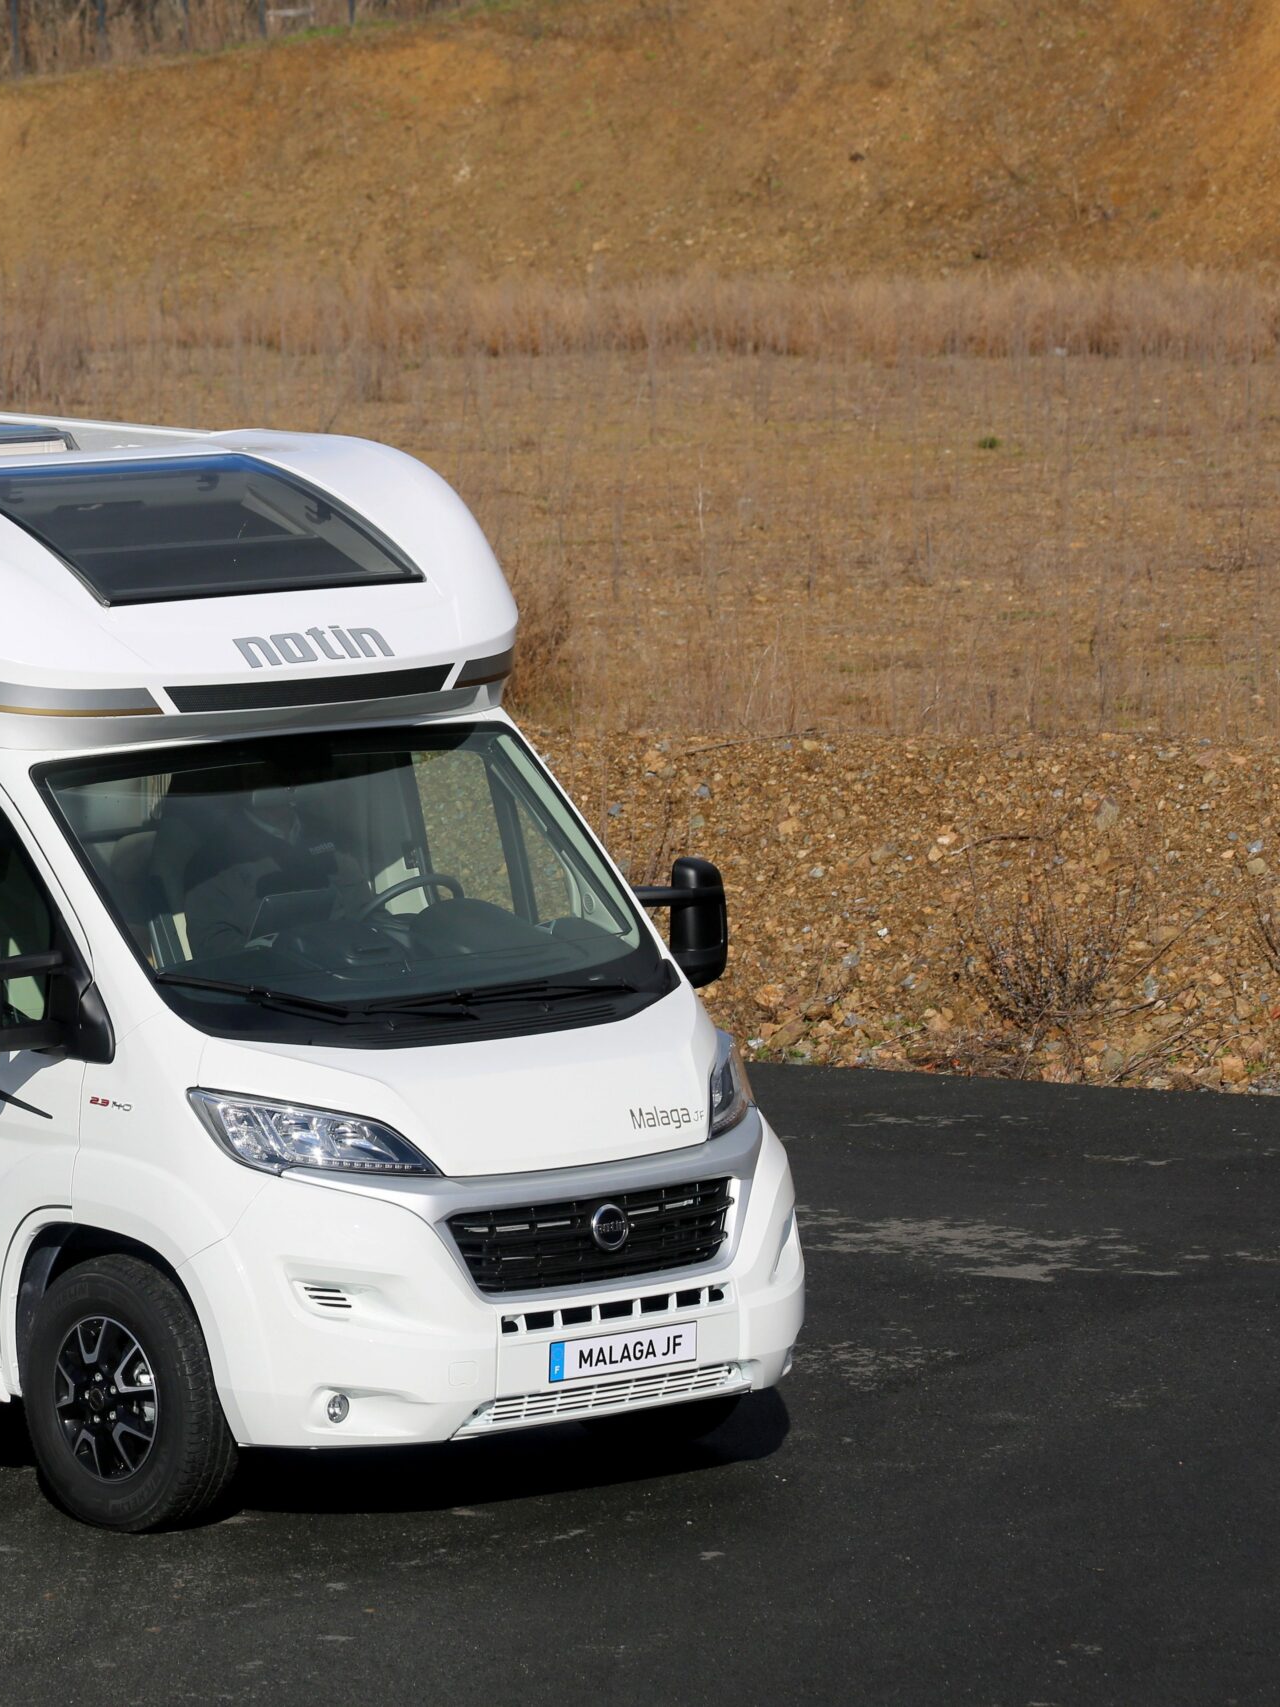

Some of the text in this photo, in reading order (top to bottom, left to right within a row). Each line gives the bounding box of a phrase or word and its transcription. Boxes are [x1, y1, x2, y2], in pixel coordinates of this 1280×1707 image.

[232, 625, 396, 668] notin
[629, 1105, 705, 1129] Malaga JF
[578, 1334, 683, 1369] MALAGA JF
[554, 1365, 561, 1375] F
